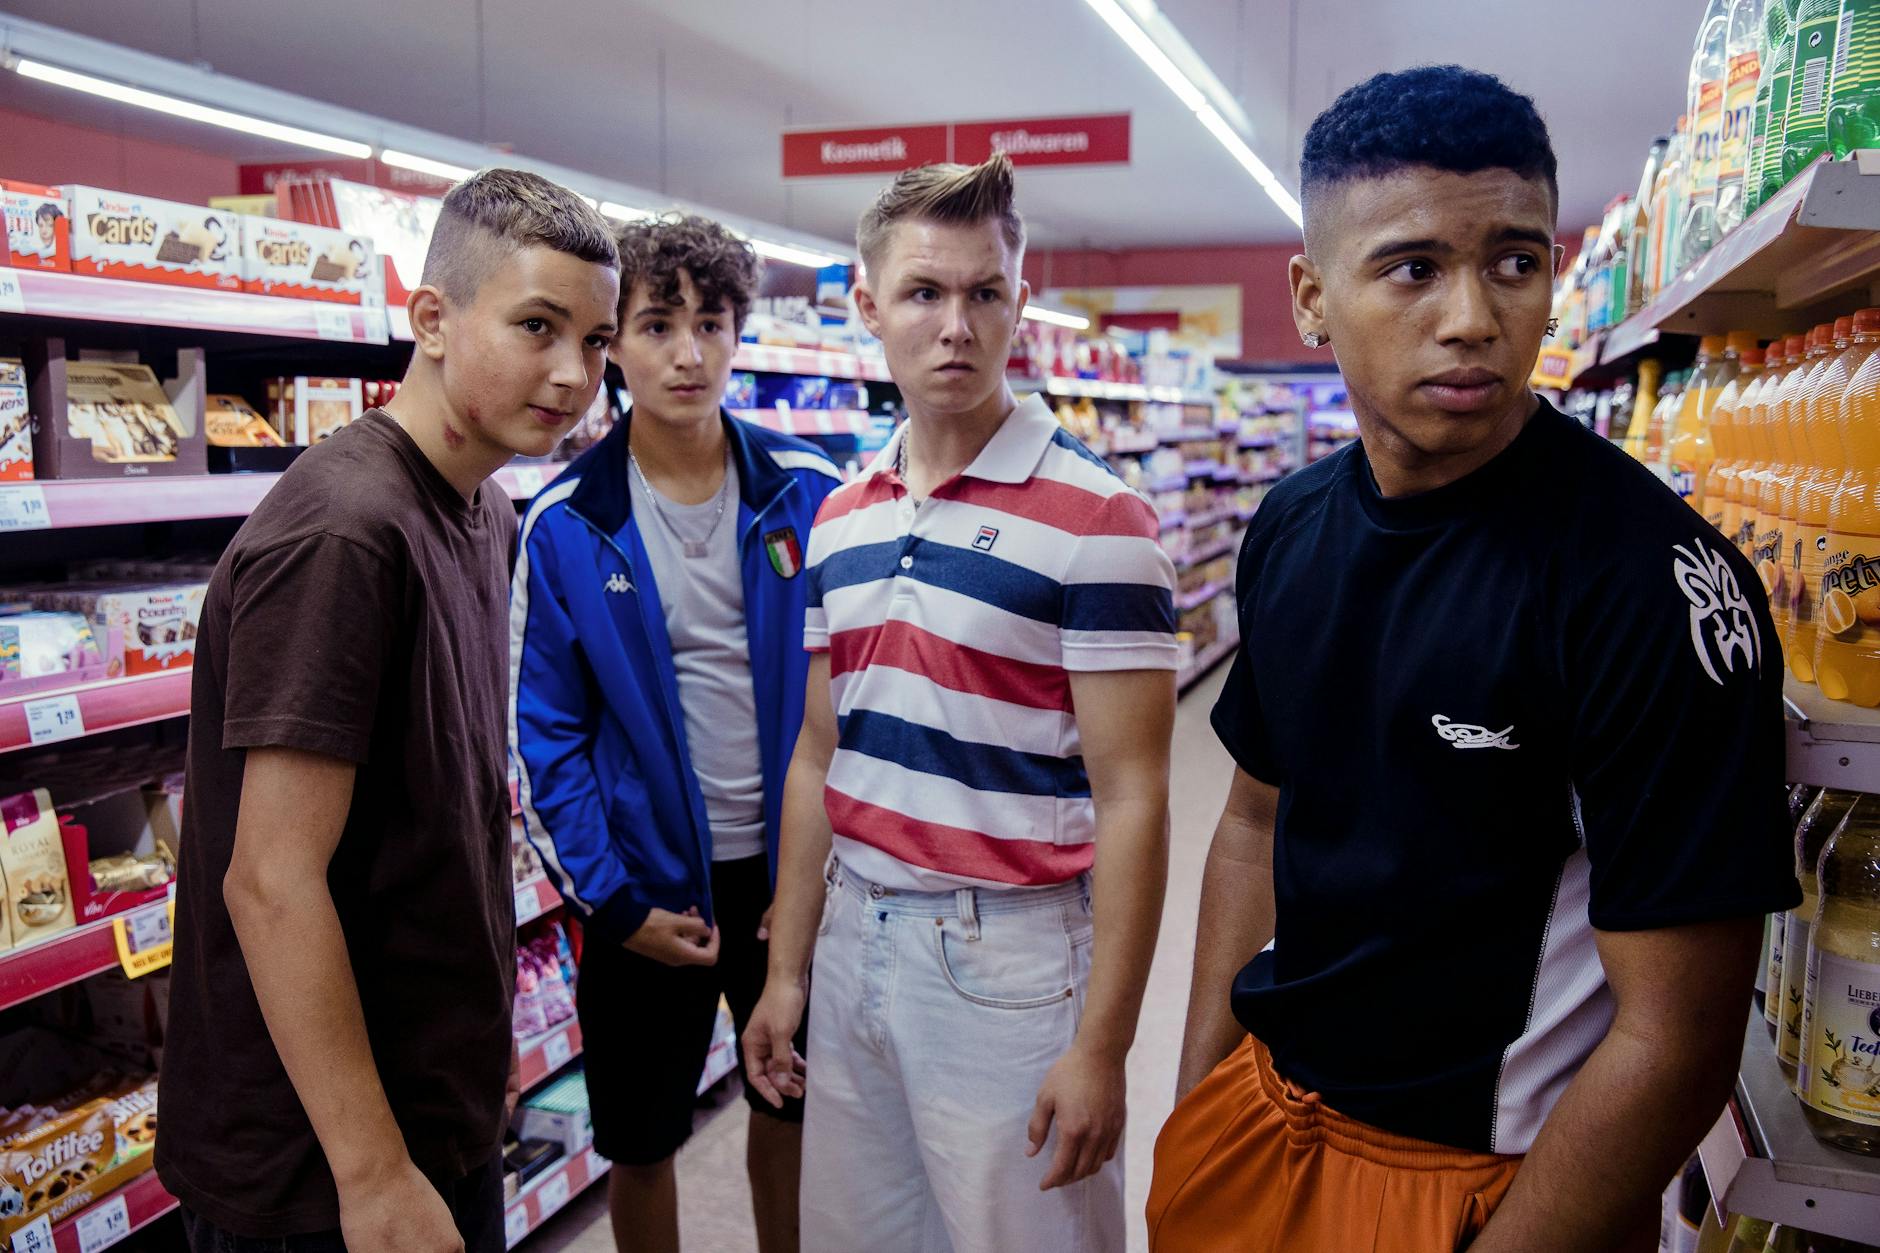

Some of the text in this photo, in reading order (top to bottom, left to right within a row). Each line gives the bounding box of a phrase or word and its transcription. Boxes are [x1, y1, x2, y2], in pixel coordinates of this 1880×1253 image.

[821, 137, 906, 164] Kosmetik
[990, 130, 1088, 157] Süßwaren
[90, 213, 156, 246] Cards
[257, 240, 310, 265] Cards
[1848, 984, 1880, 1002] LIEBE
[16, 1131, 104, 1187] Toffifee
